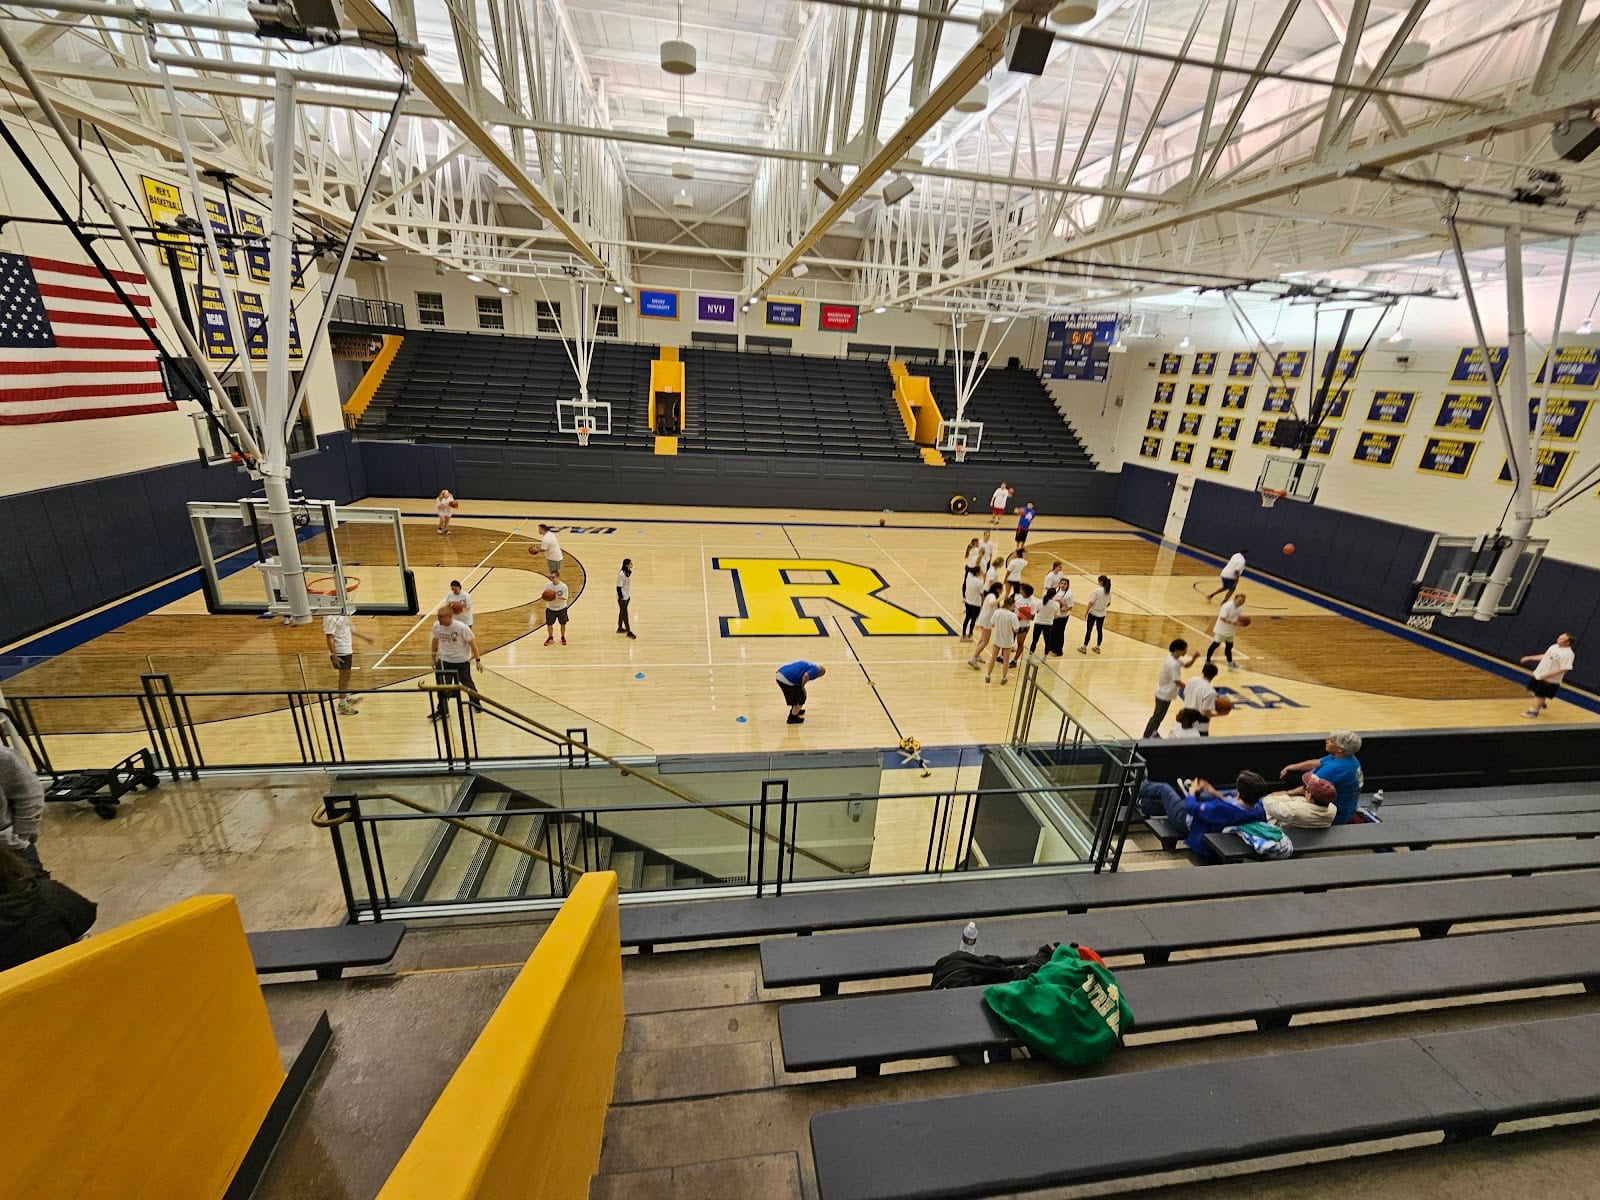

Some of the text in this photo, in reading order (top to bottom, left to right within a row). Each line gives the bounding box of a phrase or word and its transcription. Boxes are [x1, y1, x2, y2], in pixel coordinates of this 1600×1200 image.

[154, 186, 171, 198] MEN'S
[149, 195, 180, 210] BASKETBALL
[707, 304, 726, 314] NYU
[206, 313, 224, 326] NCAA
[1557, 363, 1584, 375] NCAA
[1452, 408, 1472, 419] NCAA
[1434, 454, 1455, 465] NCAA
[712, 557, 959, 637] R
